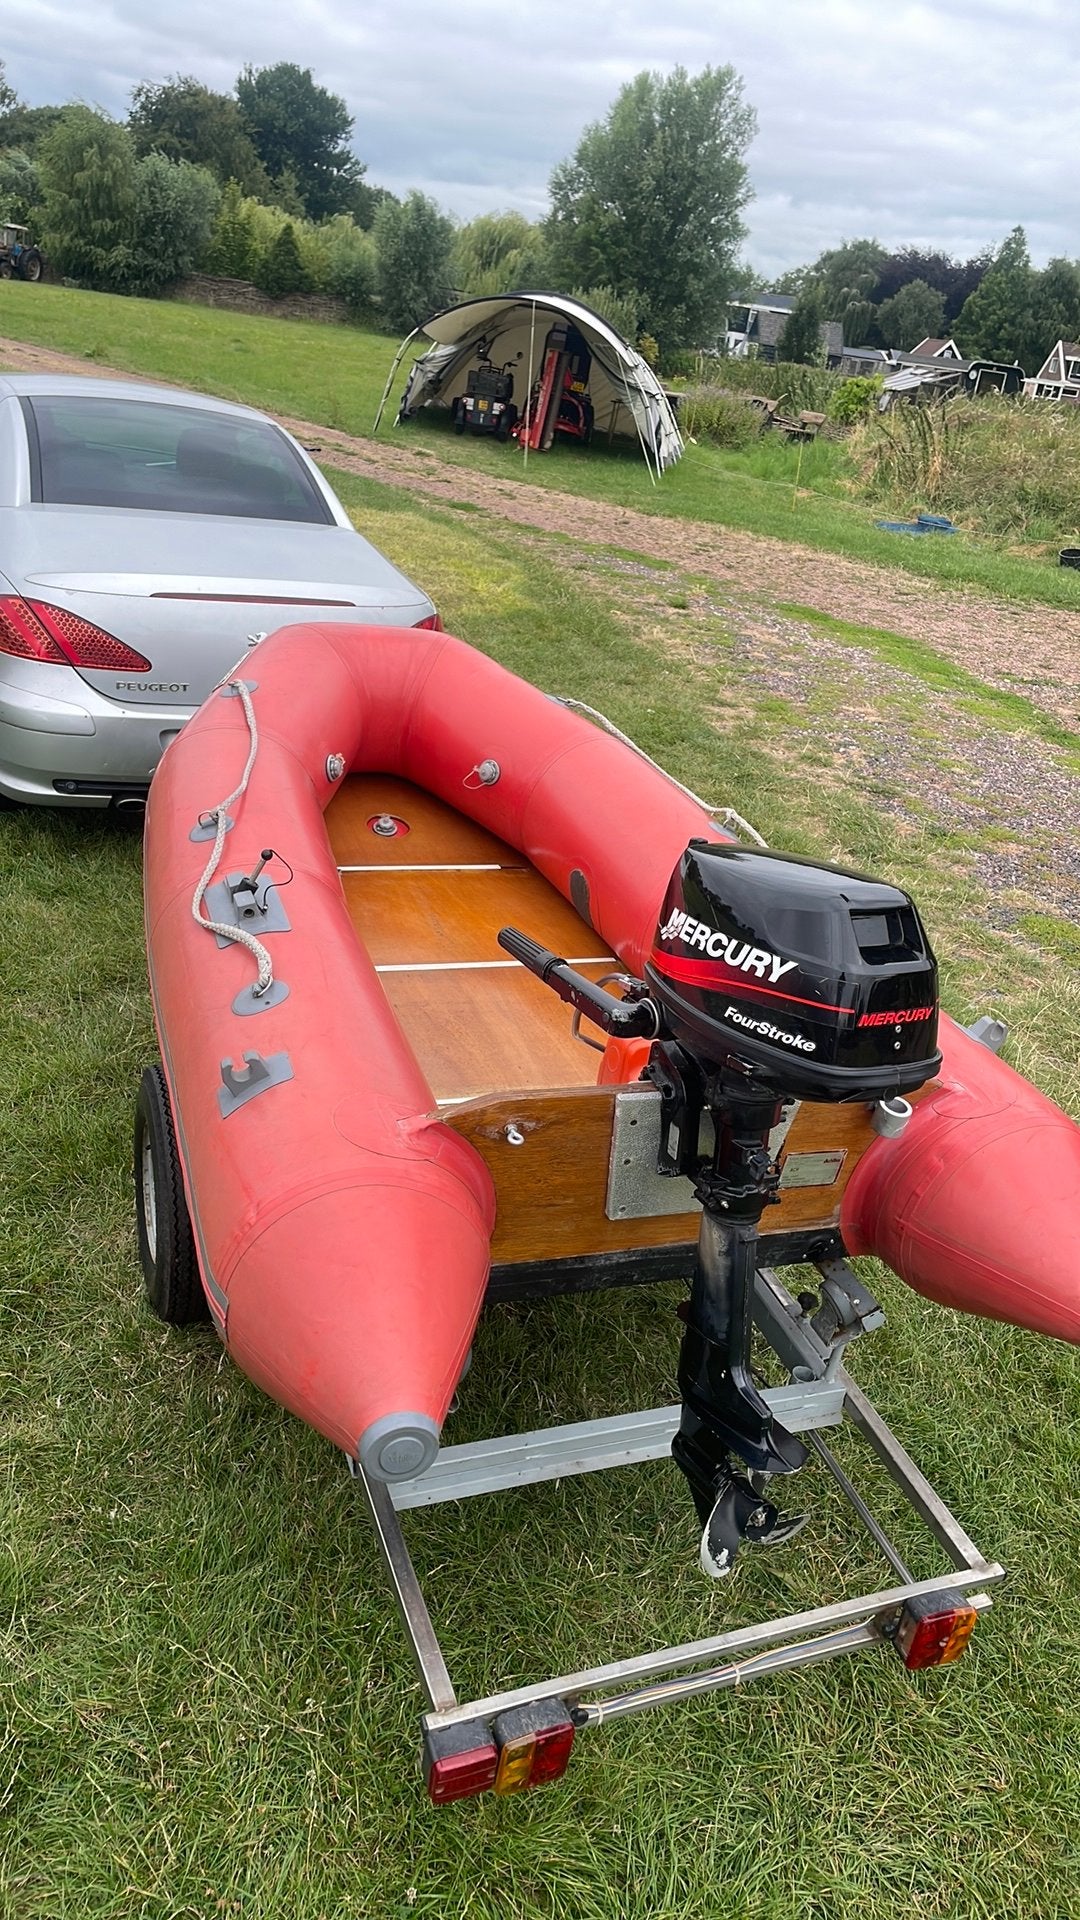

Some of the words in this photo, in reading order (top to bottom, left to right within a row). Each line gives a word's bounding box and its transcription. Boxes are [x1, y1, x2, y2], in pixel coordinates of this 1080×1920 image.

[115, 681, 190, 692] PEUGEOT
[661, 907, 799, 983] MERCURY
[723, 1006, 817, 1052] FourStroke
[857, 1006, 934, 1027] MERCURY
